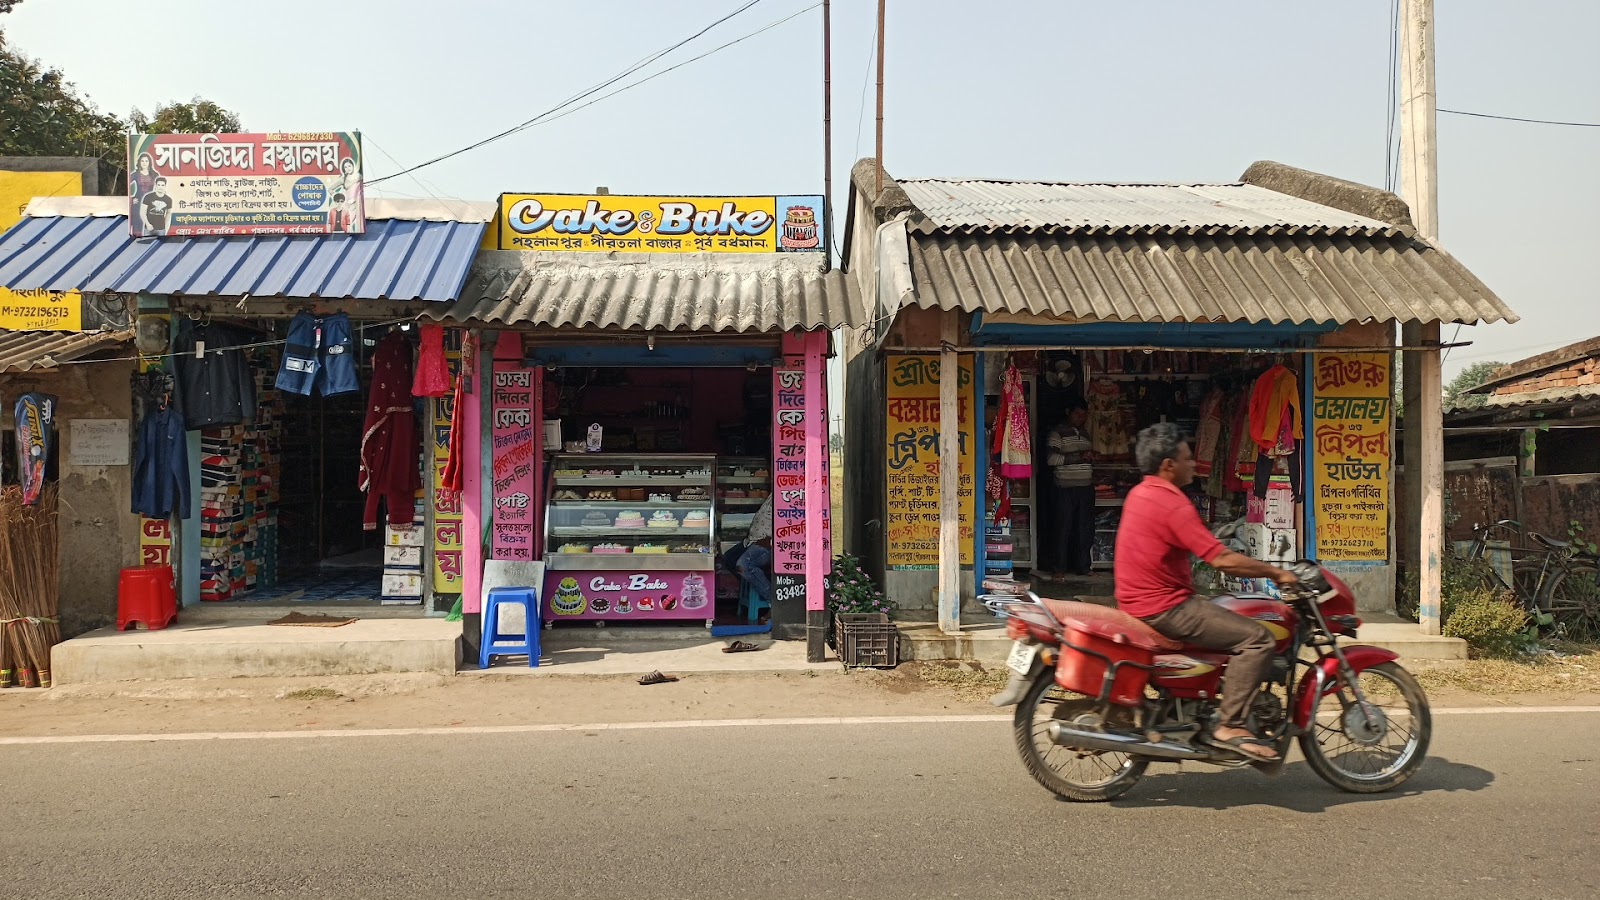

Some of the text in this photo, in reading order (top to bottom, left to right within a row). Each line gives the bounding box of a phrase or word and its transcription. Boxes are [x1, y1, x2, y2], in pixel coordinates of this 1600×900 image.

[154, 133, 339, 172] সানজিদা বস্ত্রালয়
[508, 198, 775, 236] Cake & Bake
[646, 237, 682, 249] বাজার
[2, 306, 69, 317] M-9732196513
[1314, 356, 1386, 391] শ্রীগুরু
[494, 407, 530, 429] কেক
[1323, 456, 1381, 481] হাউস
[590, 576, 622, 592] Cake
[628, 573, 669, 591] Bake
